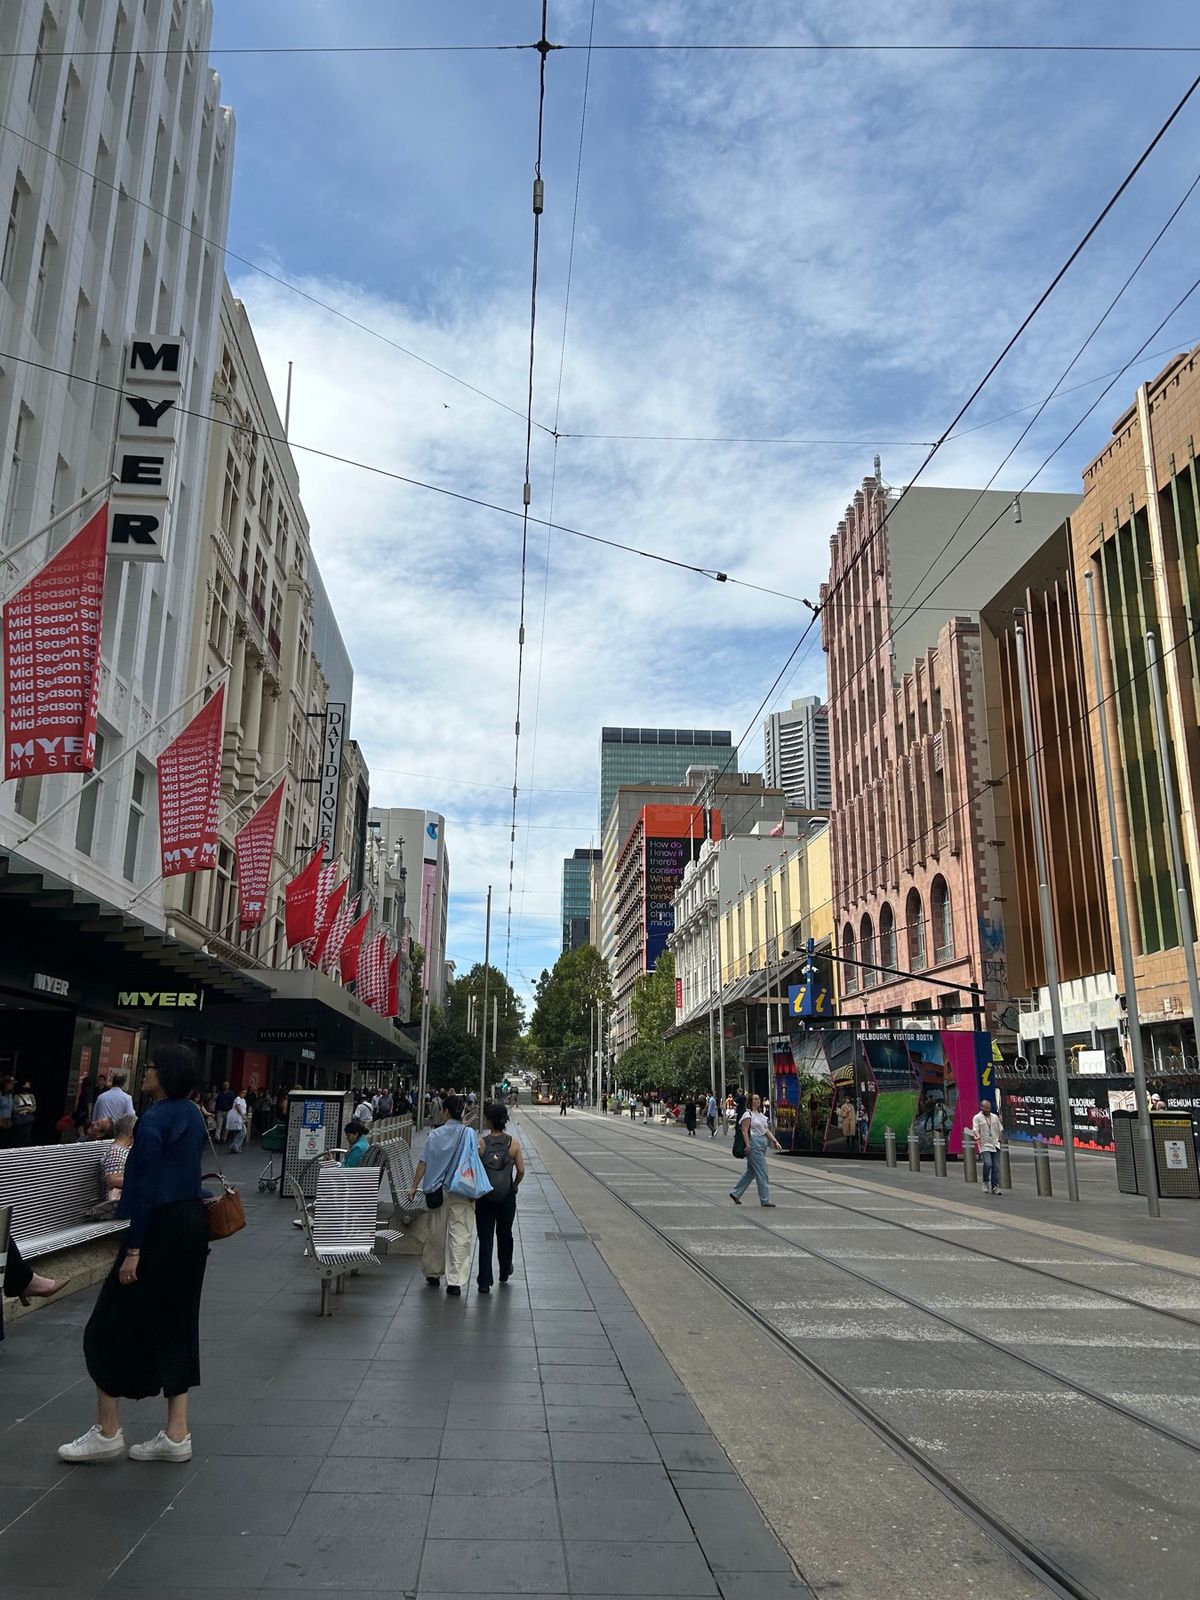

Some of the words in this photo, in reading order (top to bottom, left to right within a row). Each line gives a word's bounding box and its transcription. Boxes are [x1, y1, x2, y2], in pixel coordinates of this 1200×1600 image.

[111, 341, 180, 545] MYER
[8, 605, 31, 616] Mid
[8, 616, 31, 628] Mid
[9, 628, 32, 640] Mid
[9, 641, 33, 653] Mid
[10, 654, 33, 666] Mid
[10, 668, 33, 679] Mid
[10, 681, 34, 691] Mid
[10, 693, 34, 704] Mid
[10, 706, 34, 718] Mid
[10, 719, 35, 731] Mid
[10, 737, 84, 759] MYE
[324, 712, 341, 778] DAVID
[10, 757, 34, 772] MY
[161, 766, 177, 774] Mid
[161, 774, 178, 783] Mid
[162, 783, 178, 791] Mid
[162, 792, 178, 800] Mid
[162, 801, 179, 809] Mid
[162, 809, 179, 818] Mid
[320, 783, 335, 853] JONES
[163, 818, 179, 827] Mid
[163, 827, 178, 835] Mid
[164, 835, 178, 844] Mid
[650, 840, 669, 848] How
[671, 840, 681, 848] do
[650, 858, 677, 866] there's
[650, 867, 683, 875] consent
[650, 901, 666, 909] Can
[33, 973, 69, 996] MYER
[118, 992, 198, 1007] MYER
[1167, 1098, 1192, 1108] PREMIUM
